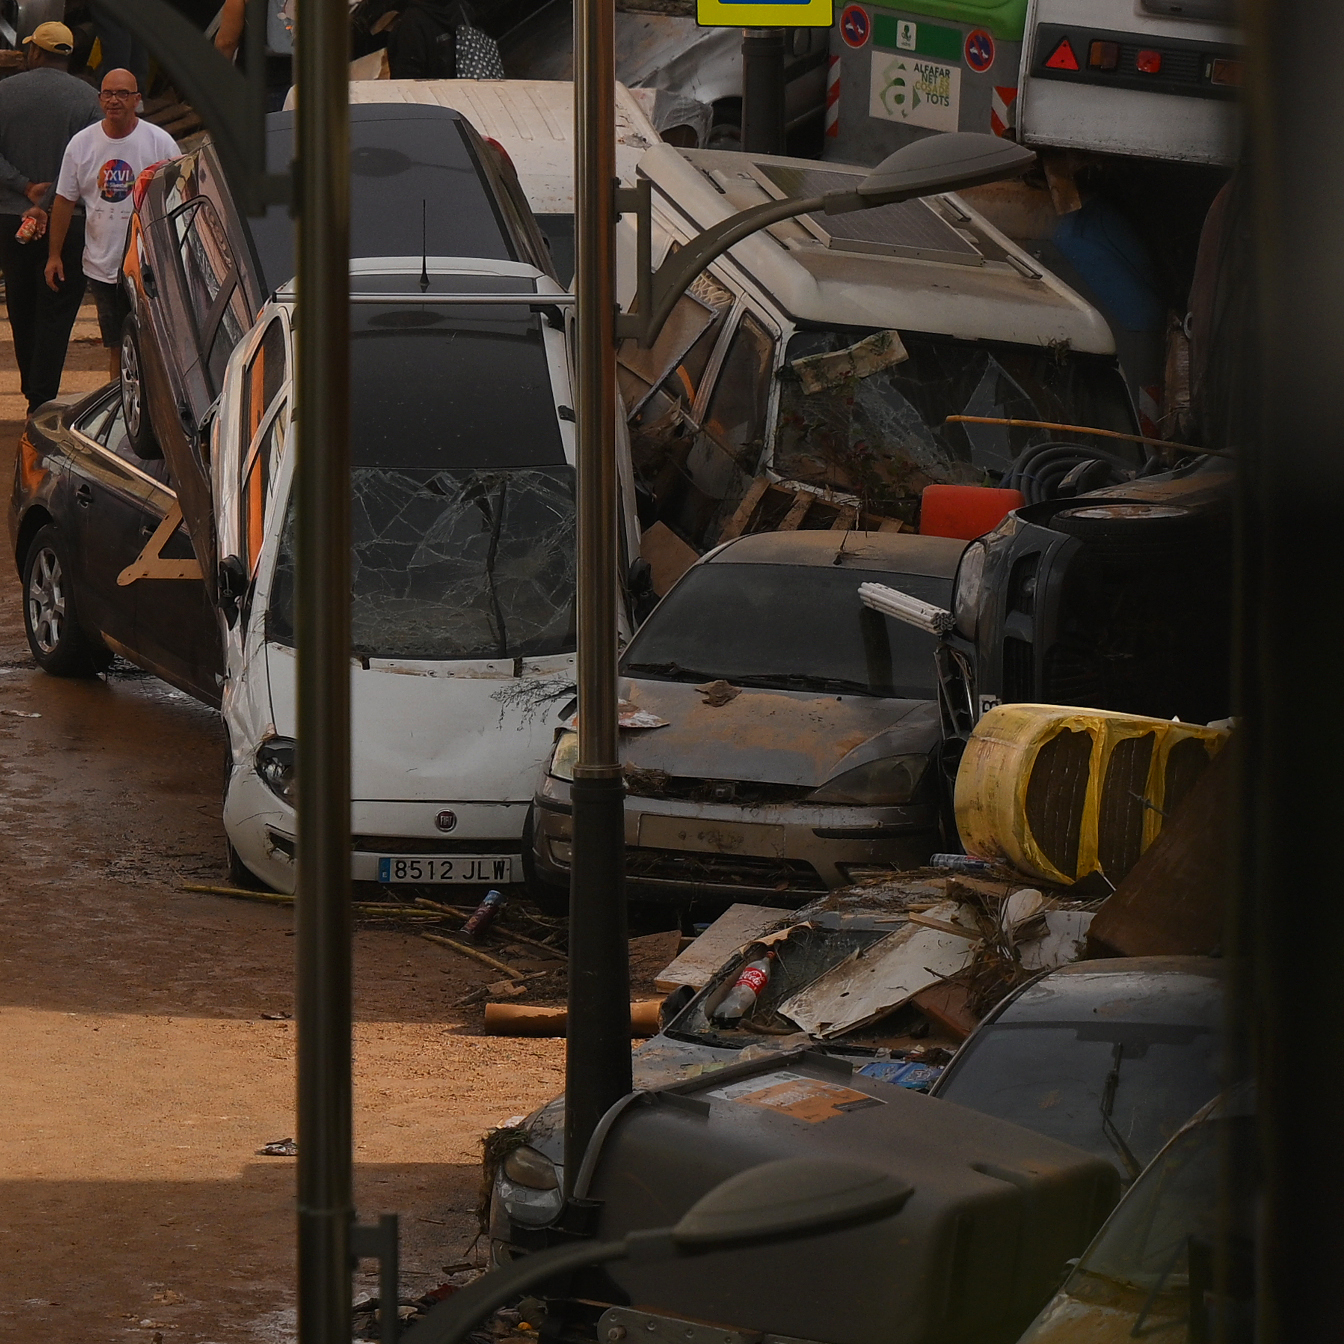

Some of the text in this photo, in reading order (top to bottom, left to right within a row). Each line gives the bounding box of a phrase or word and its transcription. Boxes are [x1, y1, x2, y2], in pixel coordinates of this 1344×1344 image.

[913, 63, 951, 79] ALFAFAR
[914, 80, 938, 93] COSA
[921, 73, 950, 87] NET ES
[925, 92, 950, 107] TOTS
[394, 860, 506, 881] 8512 JLW
